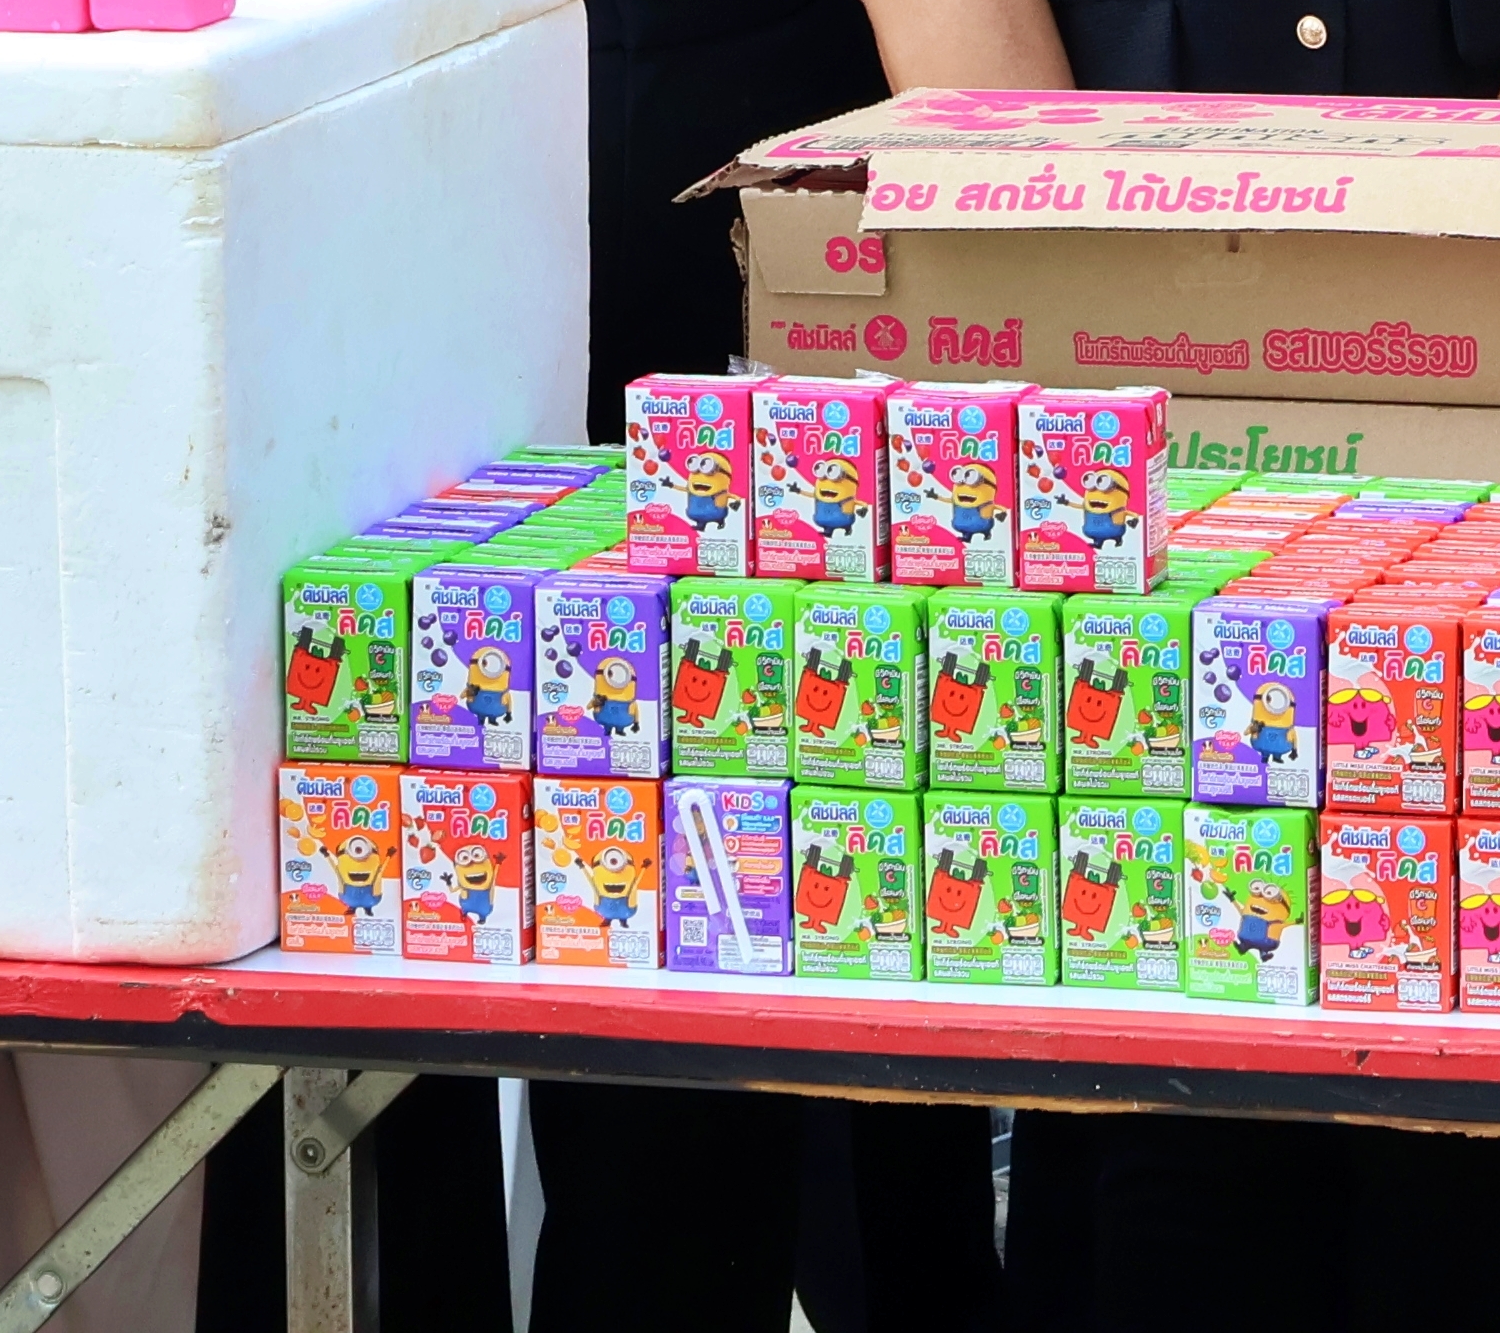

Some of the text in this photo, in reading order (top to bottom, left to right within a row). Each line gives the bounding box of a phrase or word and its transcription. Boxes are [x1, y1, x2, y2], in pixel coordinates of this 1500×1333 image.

[955, 163, 1086, 212] สดชื่น
[1105, 167, 1355, 214] ได้ประโยชน์
[787, 323, 856, 351] ดัชมิลล์
[928, 316, 1023, 367] คิดส์
[642, 397, 690, 415] ดัชมิลล์
[769, 403, 817, 421] ดัชมิลล์
[904, 409, 951, 428] ดัชมิลล์
[676, 420, 734, 449] คิดส์
[1036, 412, 1084, 433] ดัชมิลล์
[804, 426, 861, 456] คิดส์
[940, 432, 998, 461] คิดส์
[1072, 437, 1131, 466] คิดส์
[1162, 425, 1363, 476] ประโยชน์
[302, 585, 349, 604] ดัชมิลล์
[431, 587, 478, 606] ดัชมิลล์
[553, 599, 601, 618] ดัชมิลล์
[688, 597, 737, 615] ดัชมิลล์
[337, 610, 394, 638] คิดส์
[465, 611, 523, 640] คิดส์
[811, 605, 857, 626] ดัชมิลล์
[946, 609, 994, 629] ดัชมิลล์
[1083, 617, 1132, 635] ดัชมิลล์
[588, 623, 646, 651] คิดส์
[725, 620, 783, 649] คิดส์
[1213, 621, 1261, 640] ดัชมิลล์
[1347, 626, 1398, 646] ดัชมิลล์
[846, 631, 901, 660] คิดส์
[982, 634, 1041, 663] คิดส์
[1121, 640, 1180, 669] คิดส์
[1248, 647, 1306, 676] คิดส์
[1384, 652, 1444, 682] คิดส์
[296, 778, 343, 797] ดัชมิลล์
[416, 786, 463, 805] ดัชมิลล์
[551, 789, 599, 808] ดัชมิลล์
[722, 792, 764, 811] KIDS
[331, 802, 389, 830] คิดส์
[451, 810, 508, 839] คิดส์
[810, 802, 858, 821] ดัชมิลล์
[942, 807, 990, 825] ดัชมิลล์
[1078, 808, 1126, 828] ดัชมิลล์
[587, 813, 645, 842] คิดส์
[847, 827, 904, 855] คิดส์
[1199, 821, 1246, 841] ดัชมิลล์
[1340, 826, 1390, 847] ดัชมิลล์
[981, 831, 1037, 859] คิดส์
[1115, 834, 1173, 863] คิดส์
[1234, 845, 1292, 874] คิดส์
[1377, 853, 1437, 883] คิดส์
